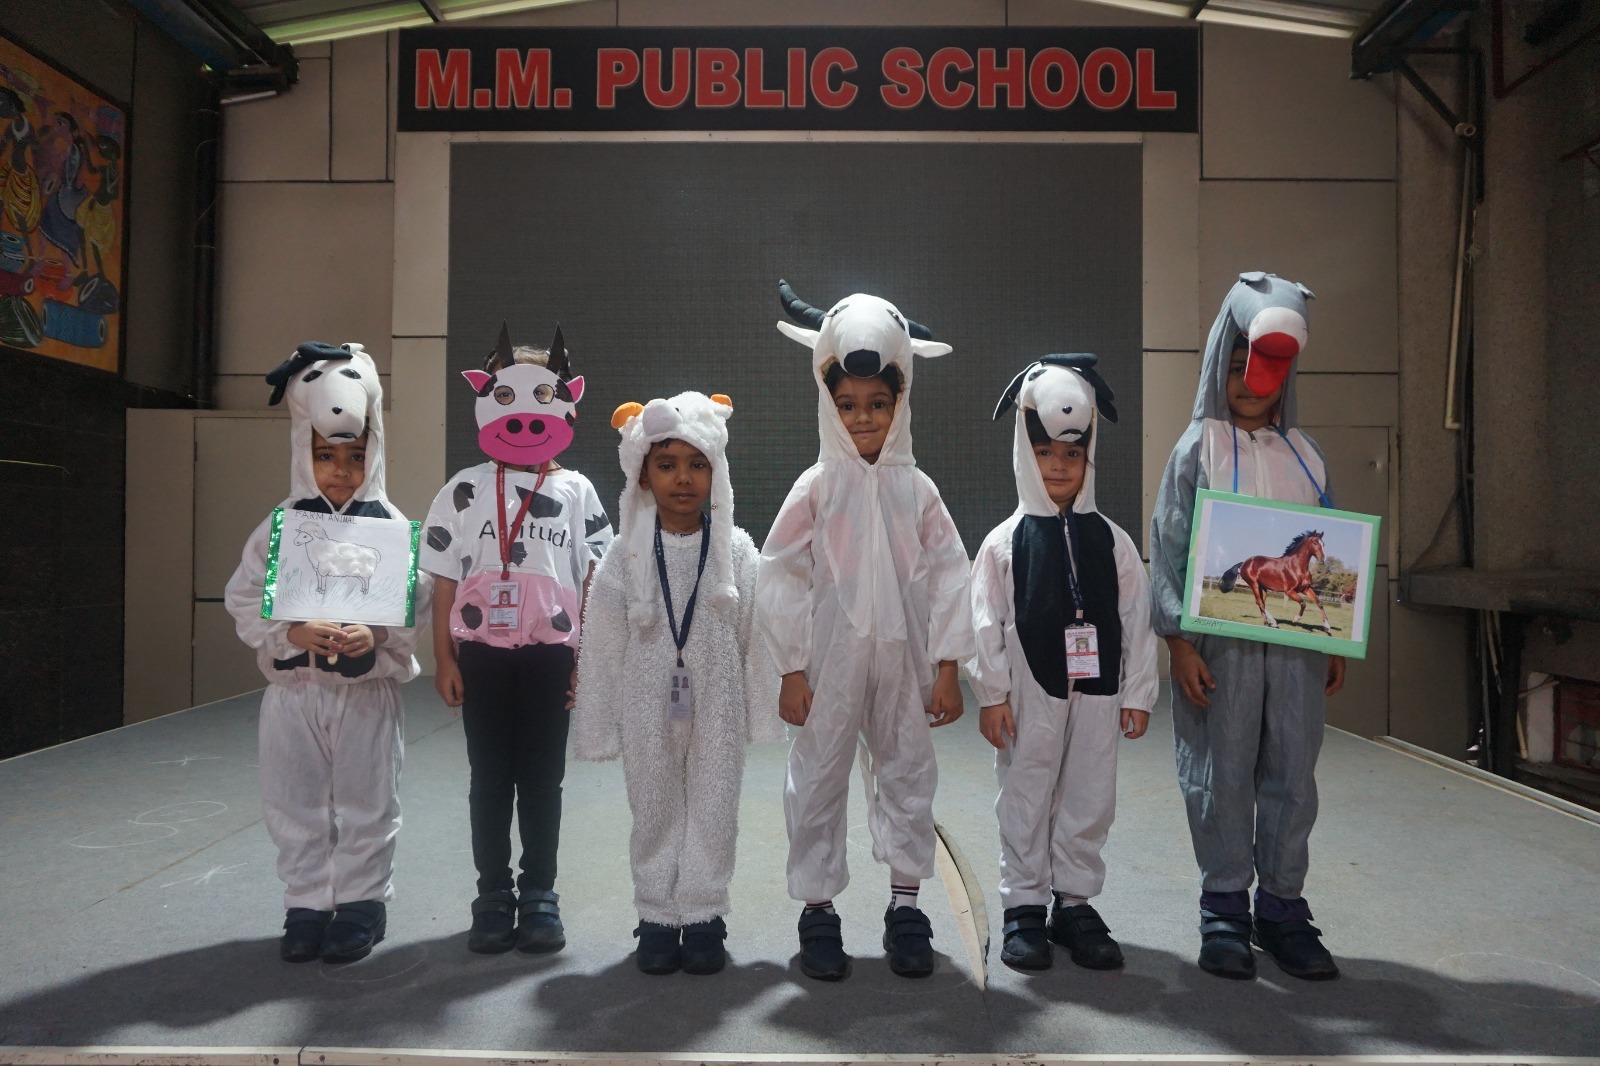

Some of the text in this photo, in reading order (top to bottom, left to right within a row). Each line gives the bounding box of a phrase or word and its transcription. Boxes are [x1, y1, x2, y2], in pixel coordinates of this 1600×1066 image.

[415, 47, 1177, 109] M.M. PUBLIC SCHOOL
